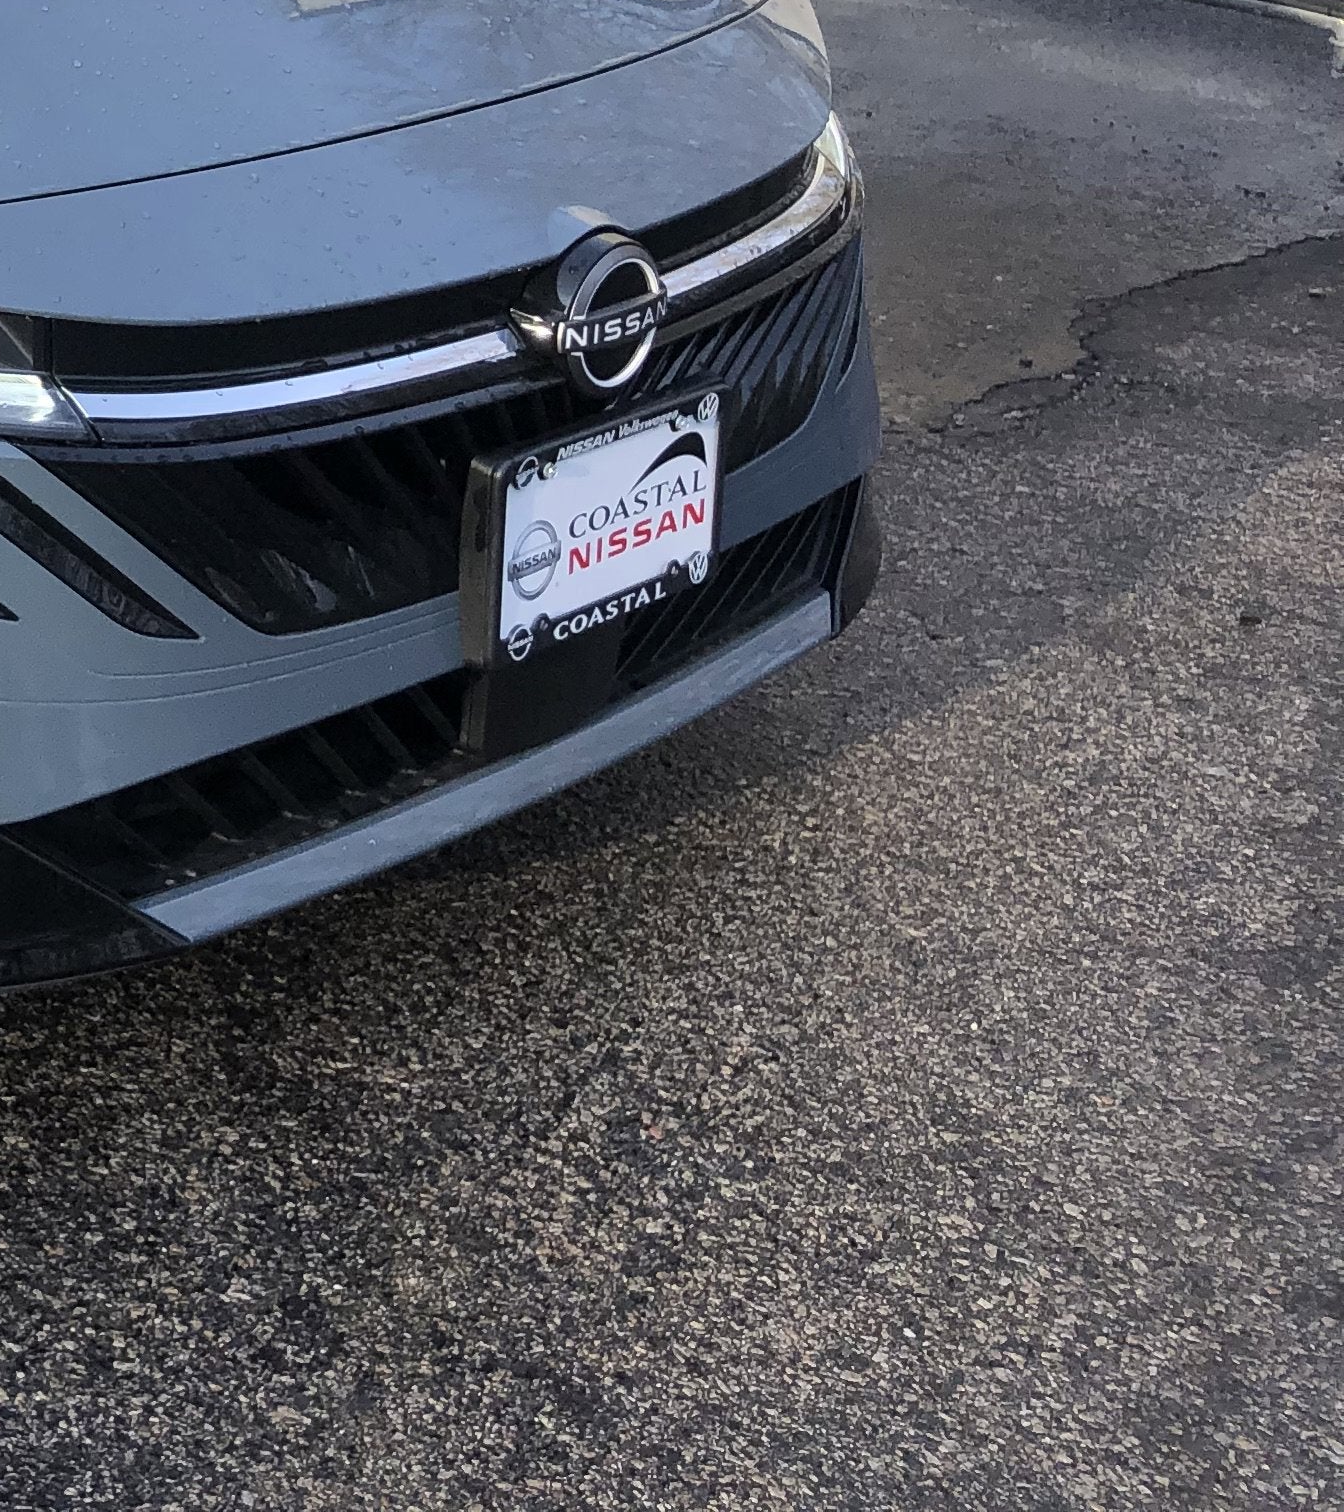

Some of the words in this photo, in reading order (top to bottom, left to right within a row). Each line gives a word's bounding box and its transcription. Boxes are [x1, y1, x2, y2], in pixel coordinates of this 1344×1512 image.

[565, 296, 668, 350] NISSAN
[556, 429, 615, 462] NISSAN
[568, 469, 707, 539] COASTAL
[512, 547, 557, 575] NISSAN
[568, 498, 706, 576] NISSAN
[552, 581, 667, 641] COASTAL
